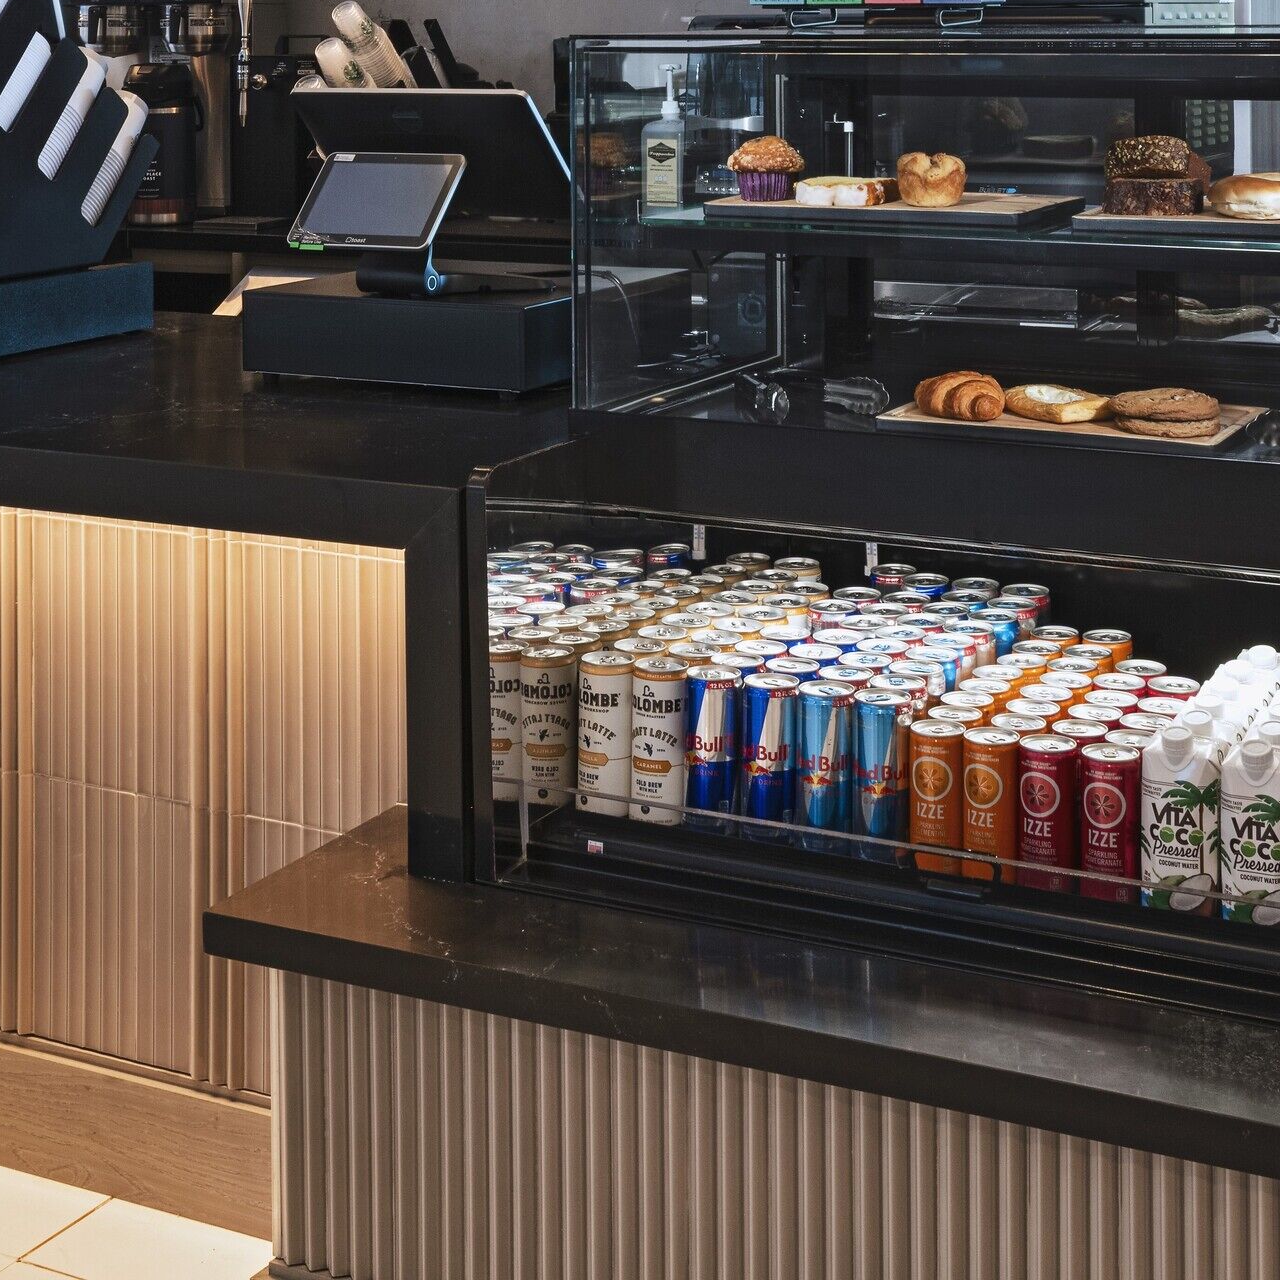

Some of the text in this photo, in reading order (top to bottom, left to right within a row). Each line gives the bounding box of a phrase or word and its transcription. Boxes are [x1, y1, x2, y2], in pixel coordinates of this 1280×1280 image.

[582, 677, 592, 691] La
[642, 685, 655, 698] La
[580, 689, 619, 708] LOMBE
[632, 694, 681, 714] OLOMBE
[587, 720, 616, 741] LATTE
[649, 728, 678, 748] LATTE
[694, 735, 723, 753] Bull
[756, 744, 788, 761] Bull
[636, 761, 663, 770] CARAMEL
[818, 754, 849, 772] Bull
[647, 780, 663, 789] BREW
[916, 802, 945, 820] IZZE
[967, 808, 995, 828] IZZE
[1151, 802, 1197, 828] VITA
[1023, 817, 1052, 837] IZZE
[1231, 816, 1280, 843] VITA
[1023, 836, 1052, 849] SPARKLING
[1088, 828, 1118, 848] IZZE
[1088, 848, 1118, 860] SPARKLING
[1152, 839, 1200, 858] Pressed
[1158, 859, 1200, 870] COCONUT WATER
[1239, 873, 1280, 885] COCONUT WATER
